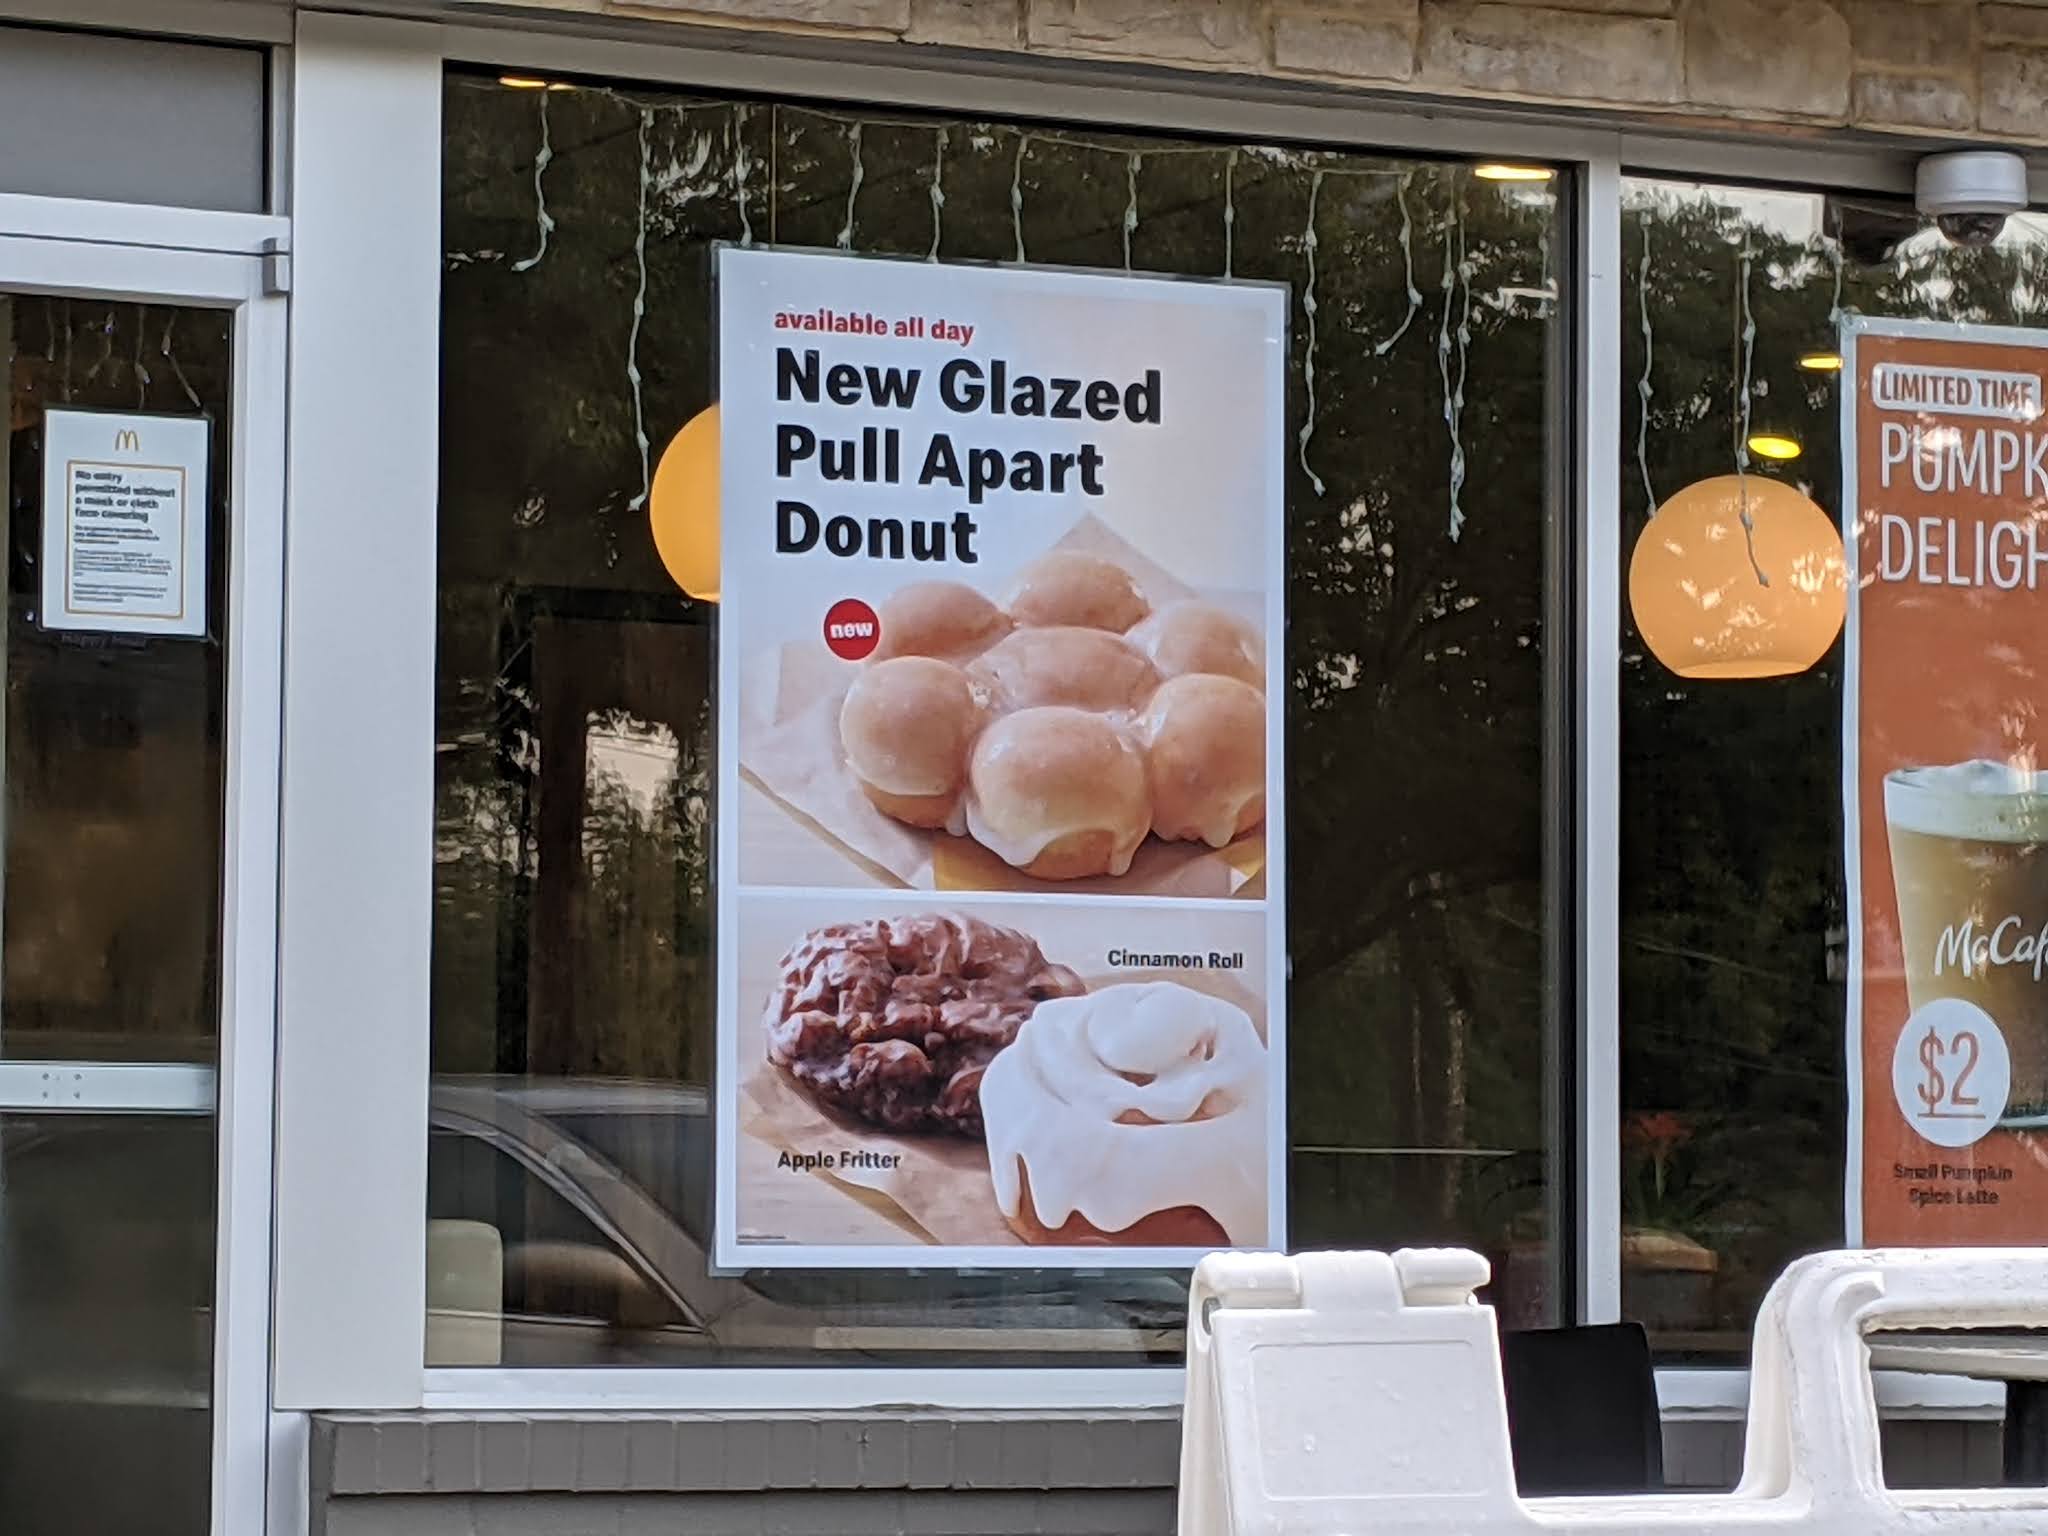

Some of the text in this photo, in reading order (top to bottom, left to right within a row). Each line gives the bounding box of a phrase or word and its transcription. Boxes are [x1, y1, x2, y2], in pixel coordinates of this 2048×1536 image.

[774, 310, 975, 347] available all day
[776, 347, 1161, 425] New Glazed
[1880, 371, 2033, 410] LIMITED TIME
[776, 424, 1105, 504] Pull Apart
[775, 500, 979, 564] Donut
[829, 622, 874, 638] new
[1107, 948, 1244, 970] Cinnamon Roll
[1933, 914, 2048, 981] McCaf
[1917, 1025, 1980, 1116] $2
[778, 1150, 901, 1174] Apple Fritter
[1893, 1163, 2013, 1186] Small Pumpkin
[1908, 1187, 1999, 1210] Spice Latte
